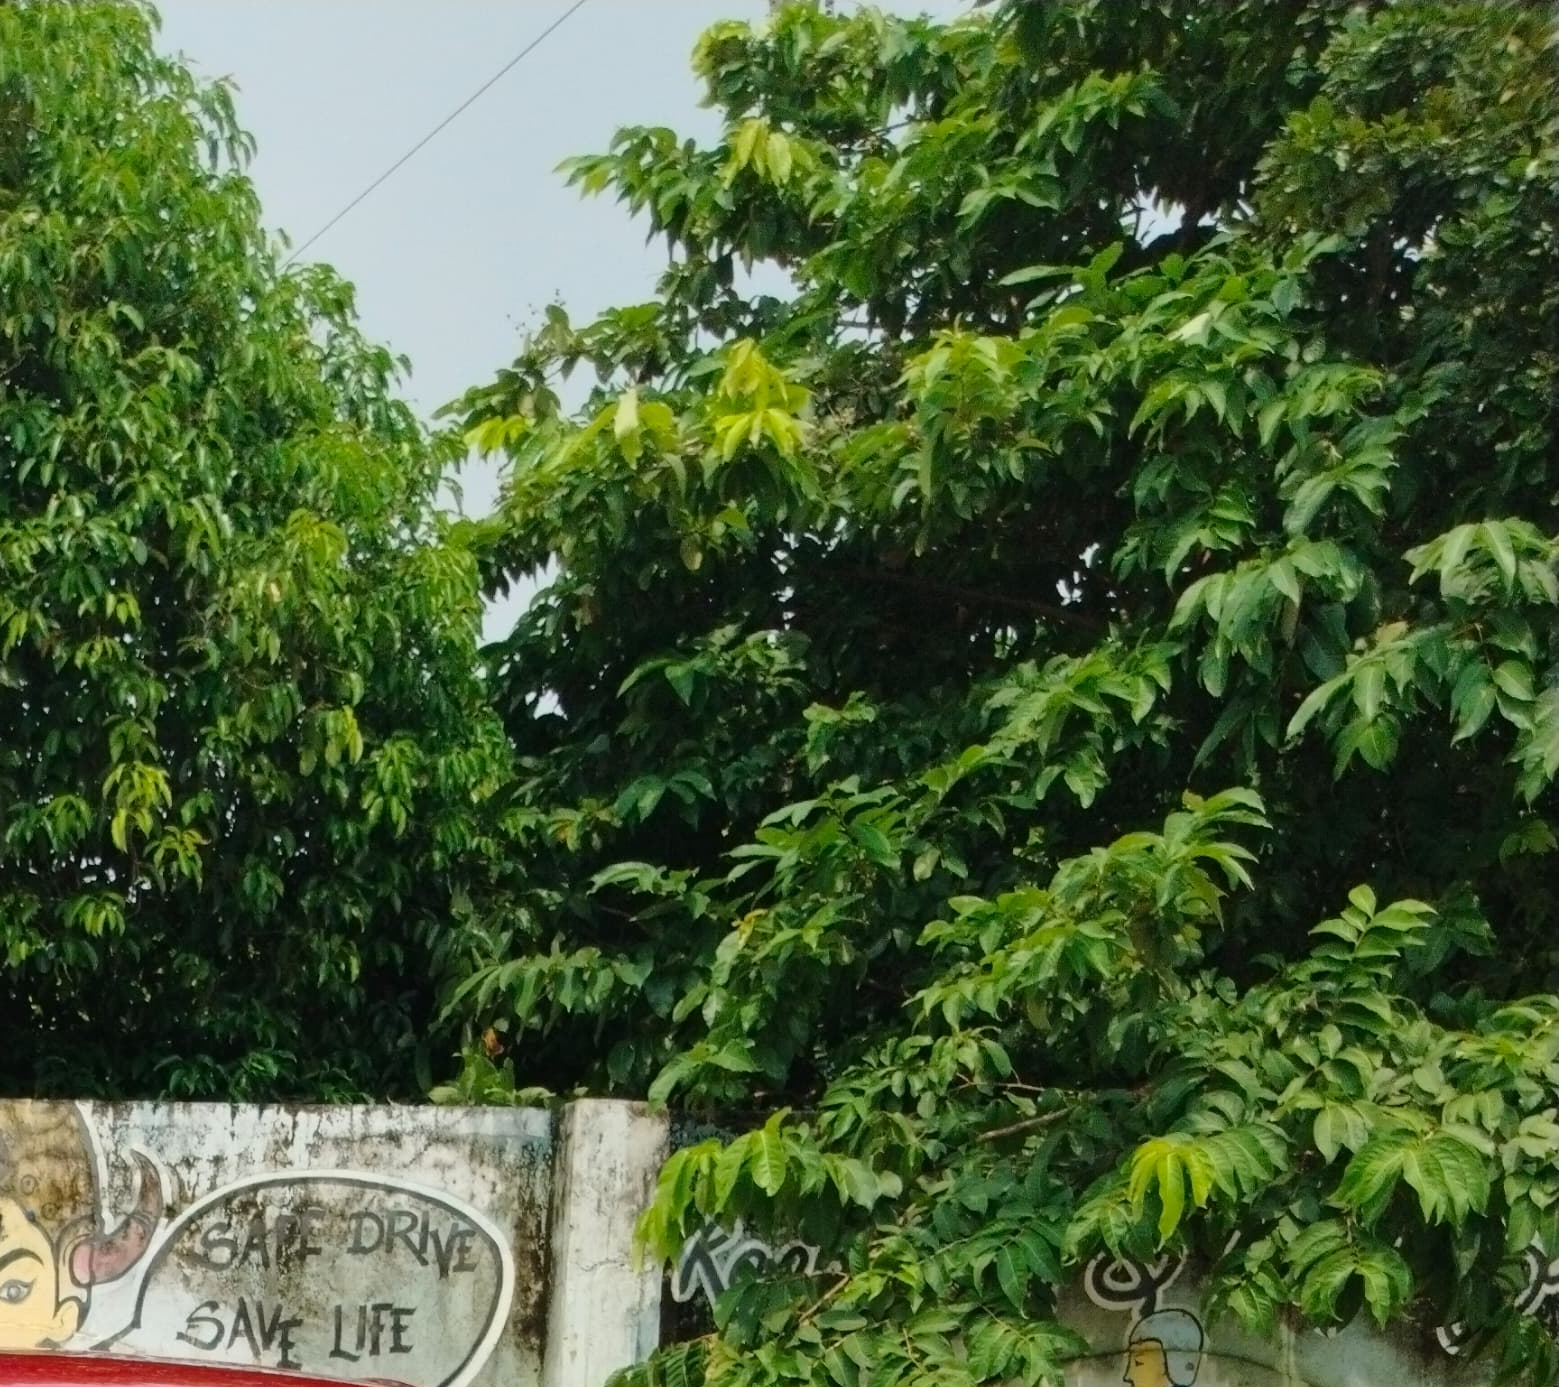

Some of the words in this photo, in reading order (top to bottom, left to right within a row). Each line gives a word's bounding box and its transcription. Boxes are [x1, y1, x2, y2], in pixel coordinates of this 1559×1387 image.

[190, 1204, 326, 1272] SAFE
[347, 1209, 478, 1280] DRIVE
[176, 1296, 303, 1371] SAVE
[329, 1303, 417, 1362] LIFE
